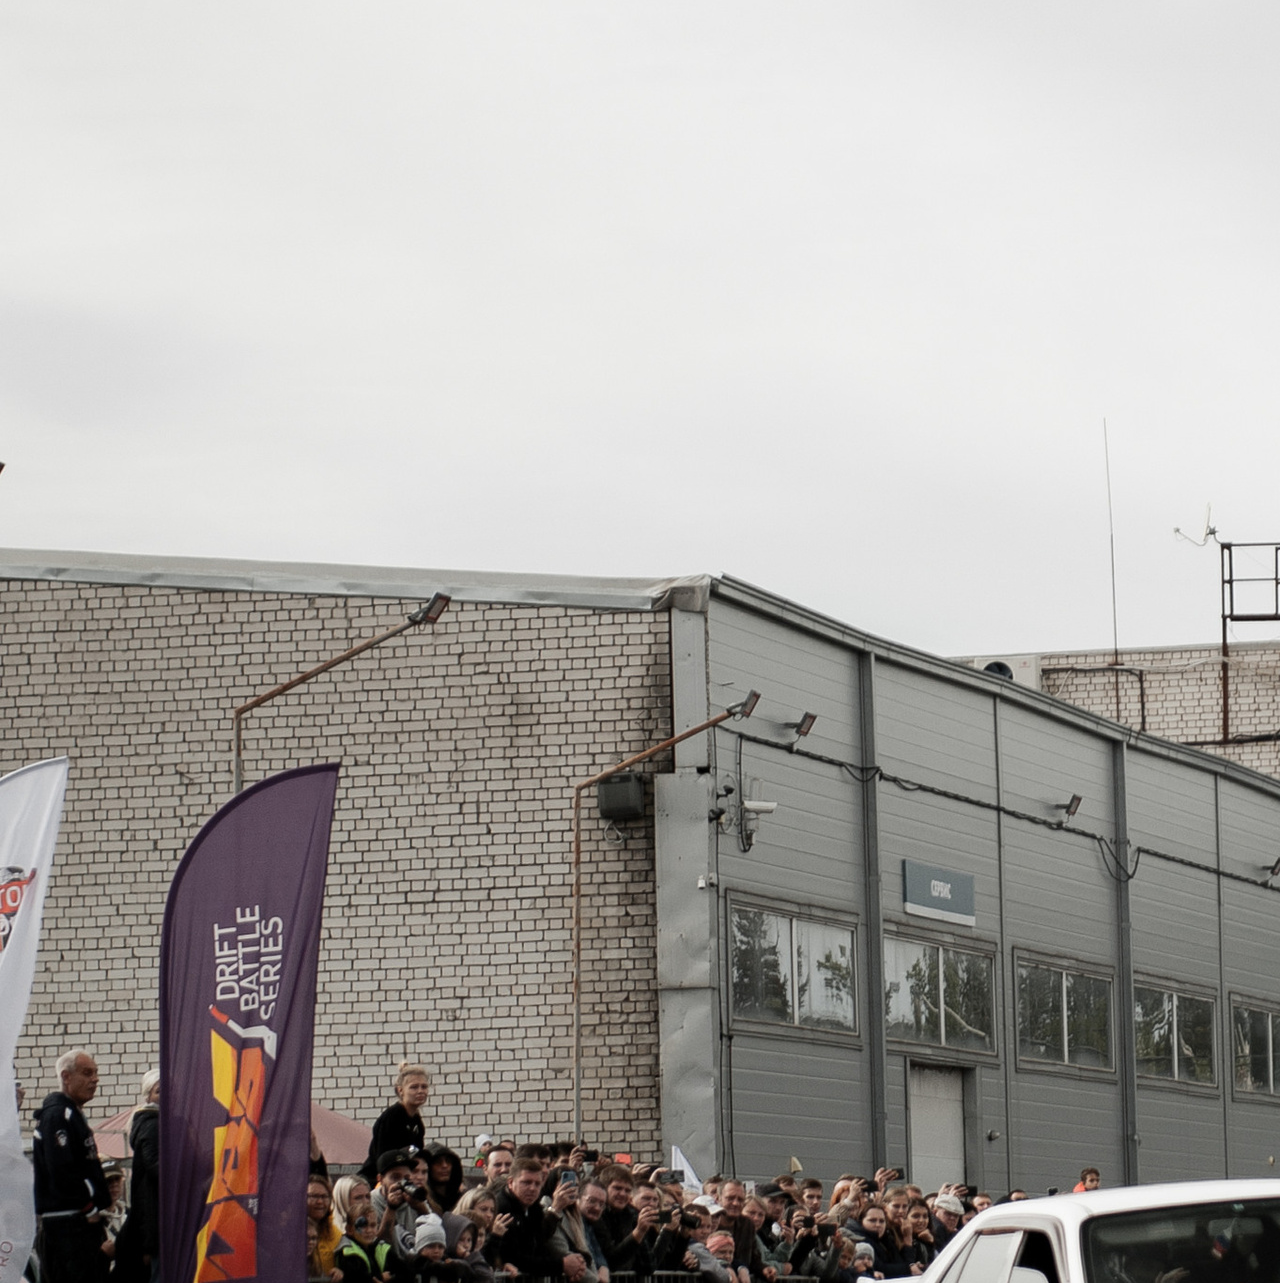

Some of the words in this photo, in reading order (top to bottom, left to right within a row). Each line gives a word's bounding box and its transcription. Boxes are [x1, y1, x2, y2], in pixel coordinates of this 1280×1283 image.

[213, 923, 240, 1000] DRIFT
[236, 905, 260, 1011] BATTLE
[260, 916, 283, 1020] SERIES
